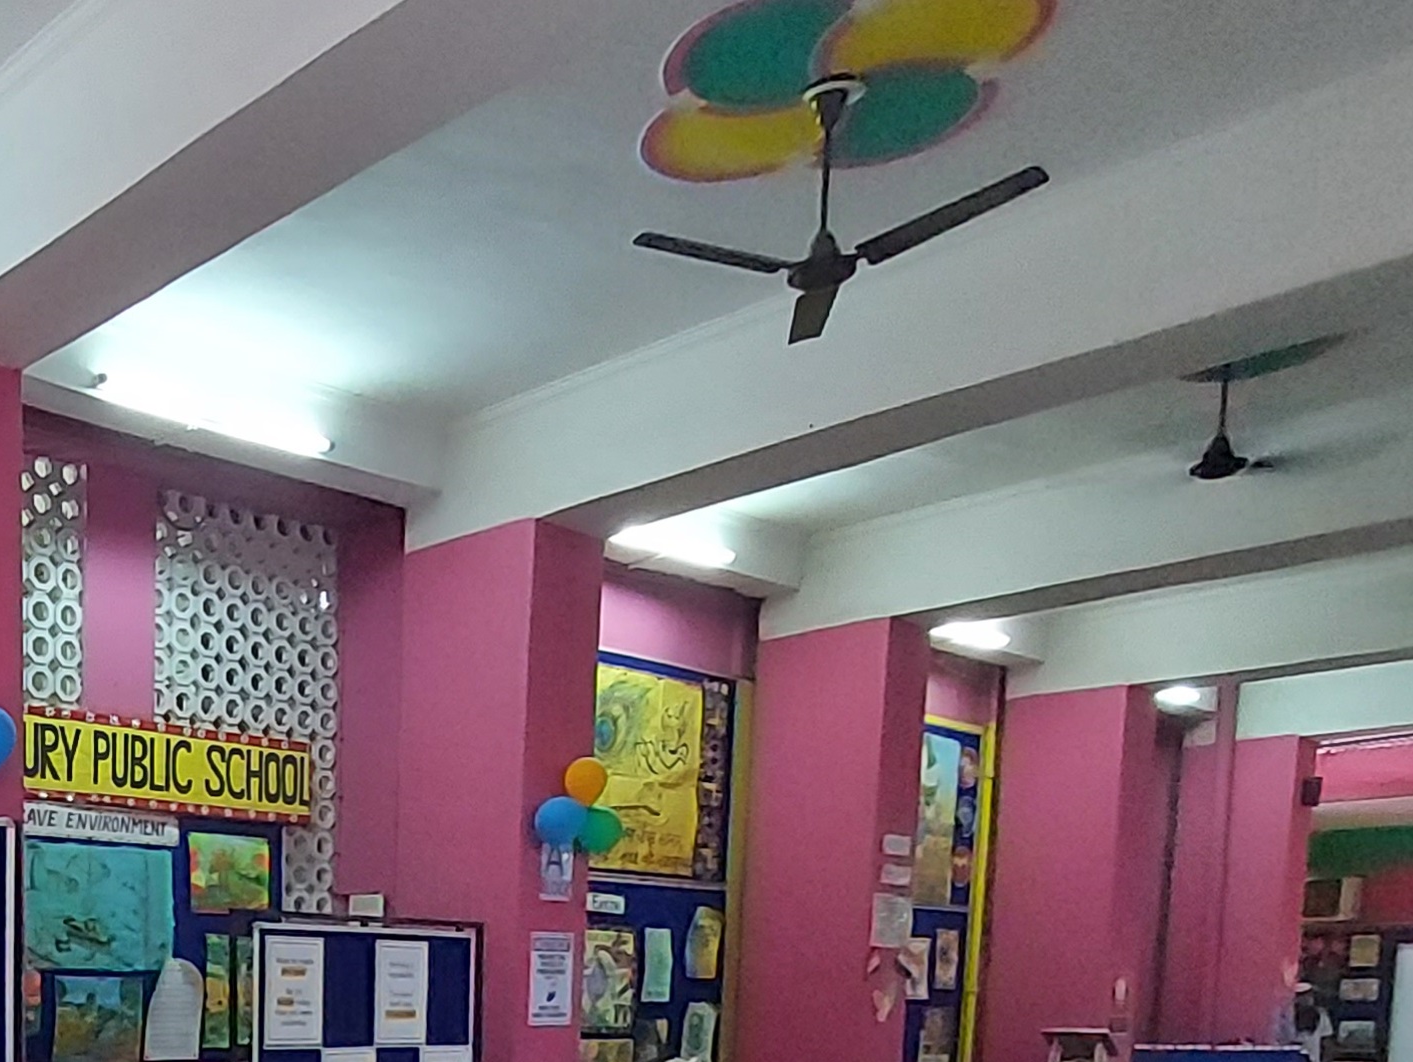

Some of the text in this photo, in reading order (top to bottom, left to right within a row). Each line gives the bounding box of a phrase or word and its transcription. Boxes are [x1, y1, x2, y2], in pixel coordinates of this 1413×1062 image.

[92, 730, 193, 794] PUBLIC
[205, 745, 310, 806] SCHOOL
[65, 812, 167, 836] ENVIRONMENT
